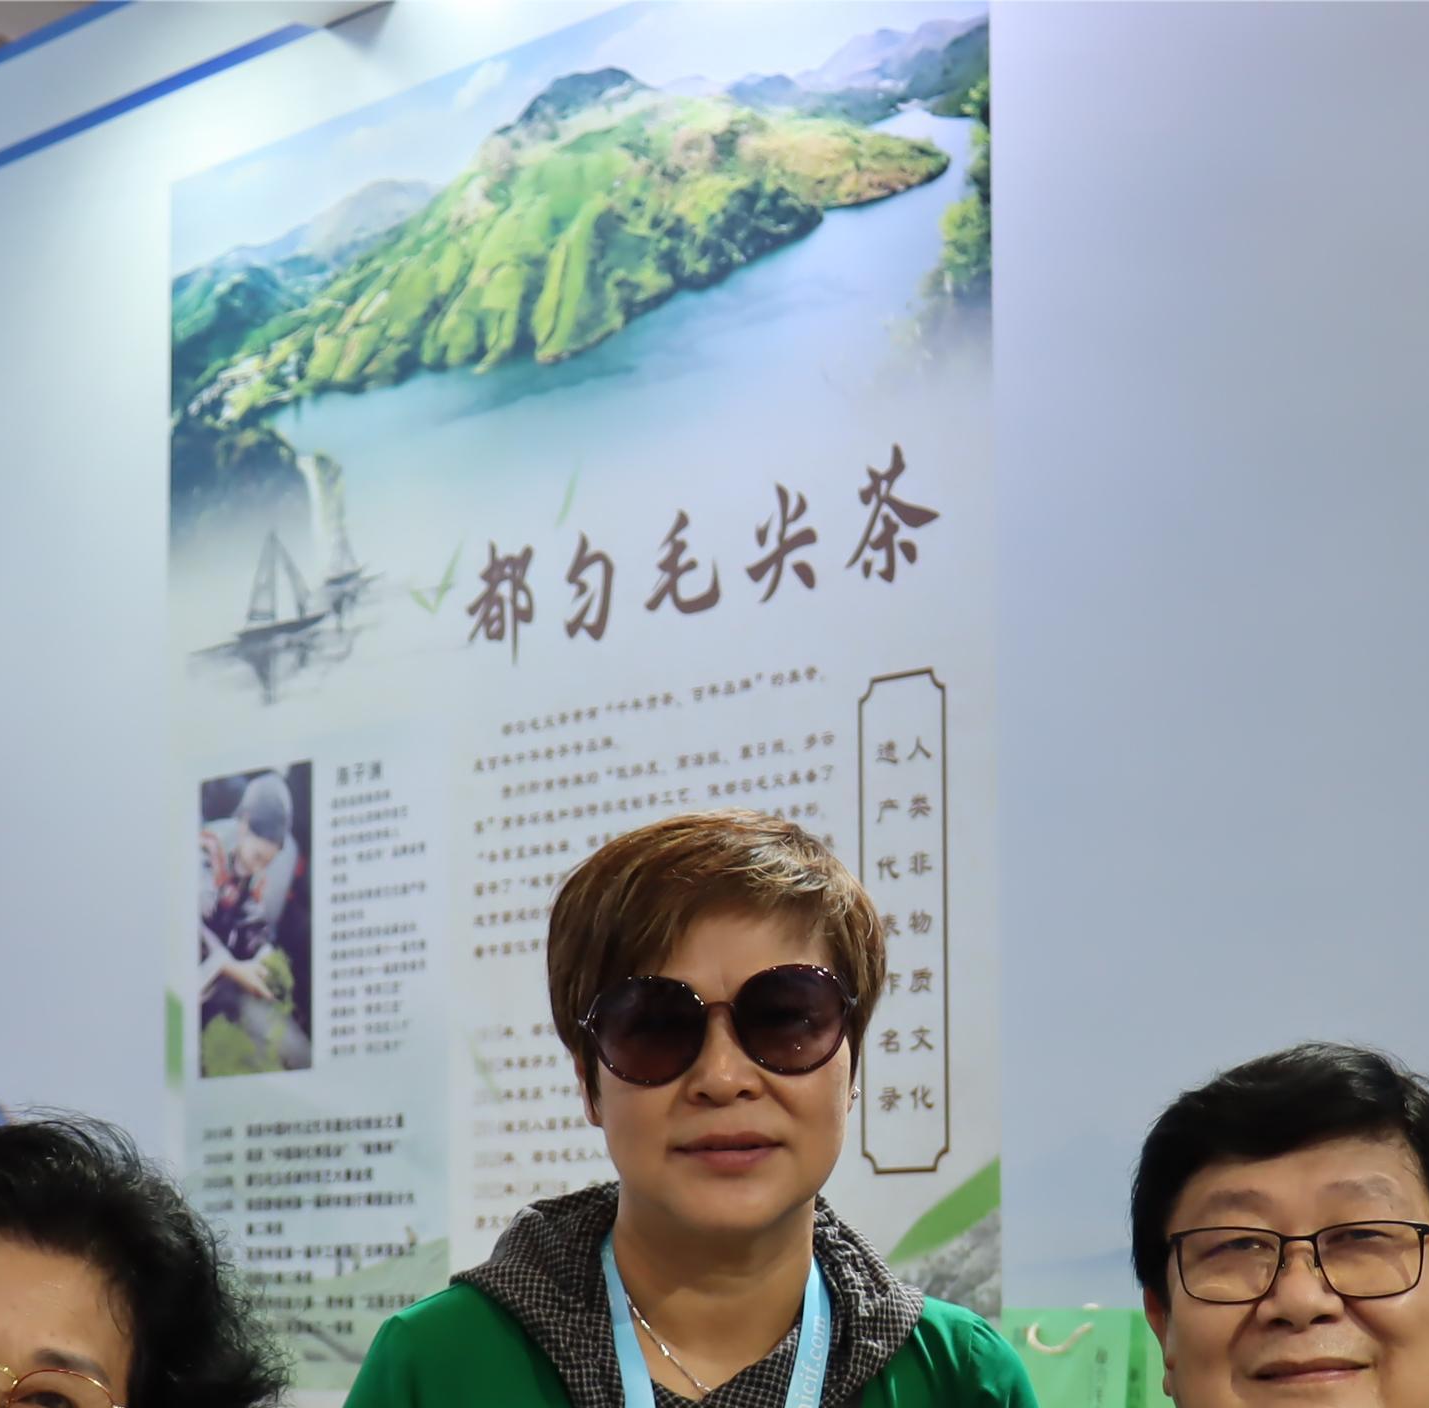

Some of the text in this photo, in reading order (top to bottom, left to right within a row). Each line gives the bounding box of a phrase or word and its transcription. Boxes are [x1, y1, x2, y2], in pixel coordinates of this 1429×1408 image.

[466, 442, 941, 666] 都匀毛尖茶
[906, 735, 937, 1112] 人类非物质文化
